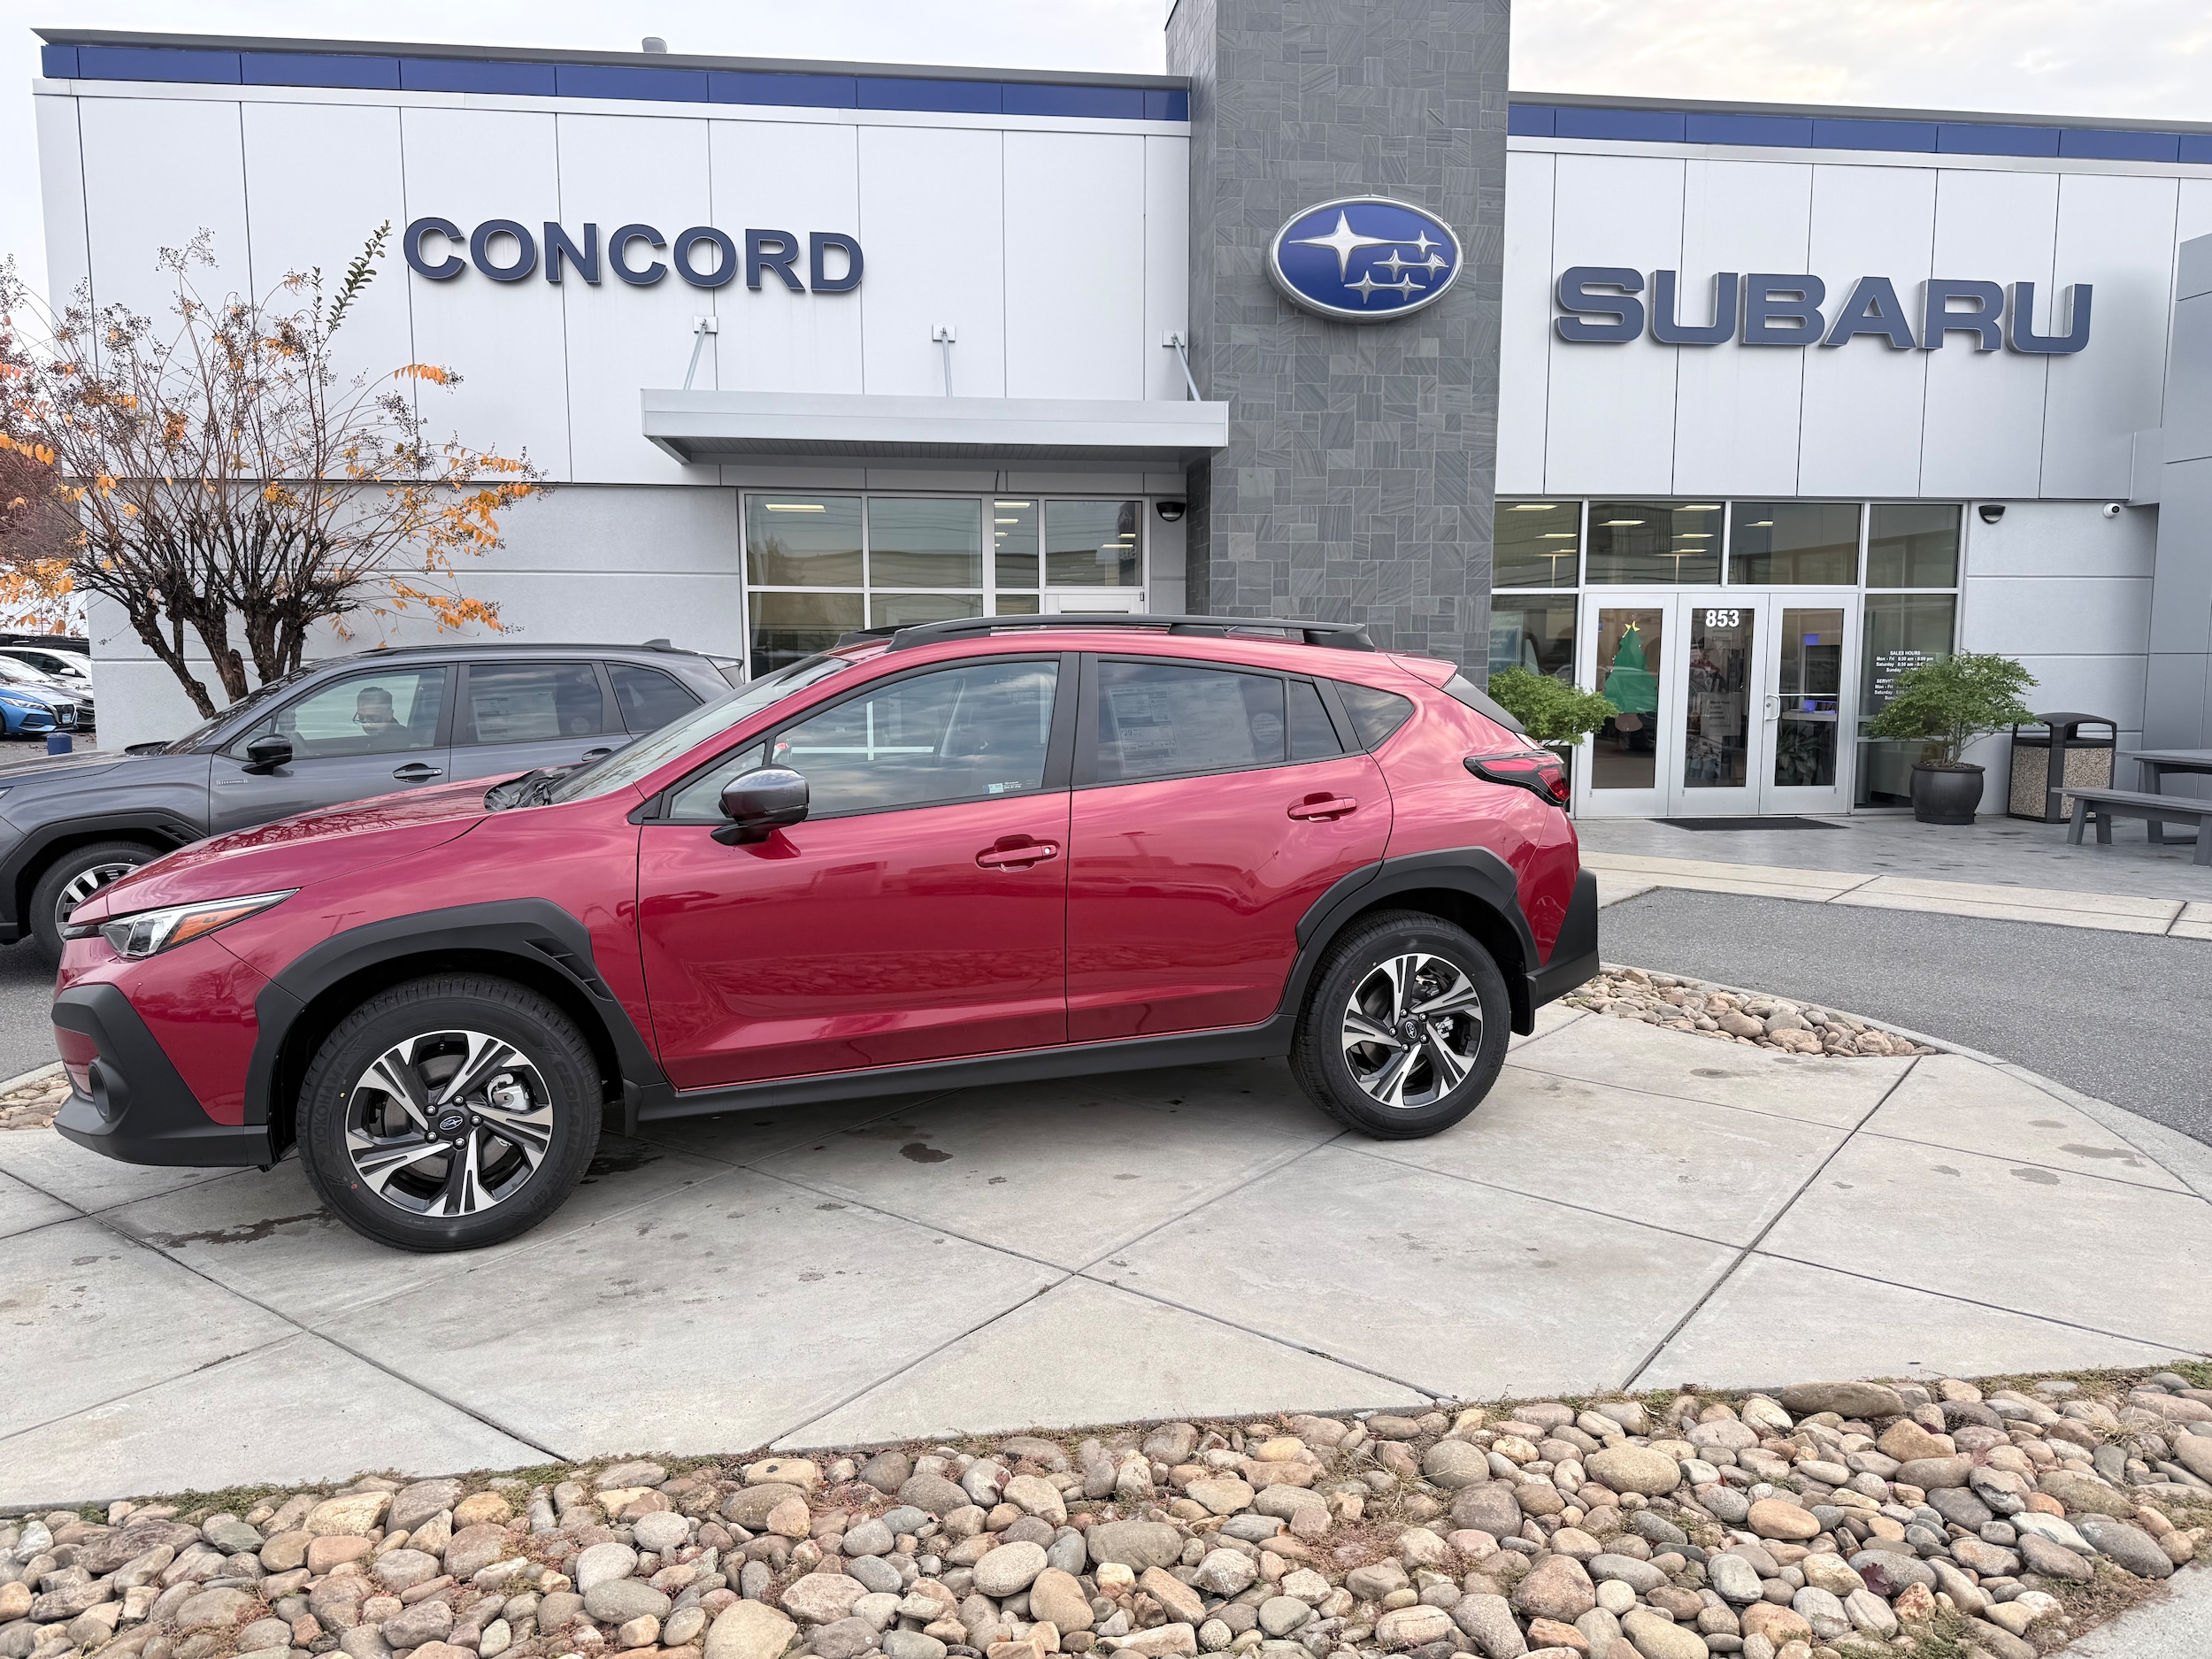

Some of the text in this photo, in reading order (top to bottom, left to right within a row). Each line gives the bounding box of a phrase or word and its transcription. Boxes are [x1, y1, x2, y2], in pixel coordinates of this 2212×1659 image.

[403, 217, 864, 294] CONCORD
[1555, 265, 2093, 356] SUBARU
[1705, 609, 1740, 627] 853
[313, 1060, 351, 1147] YOKOHAMA
